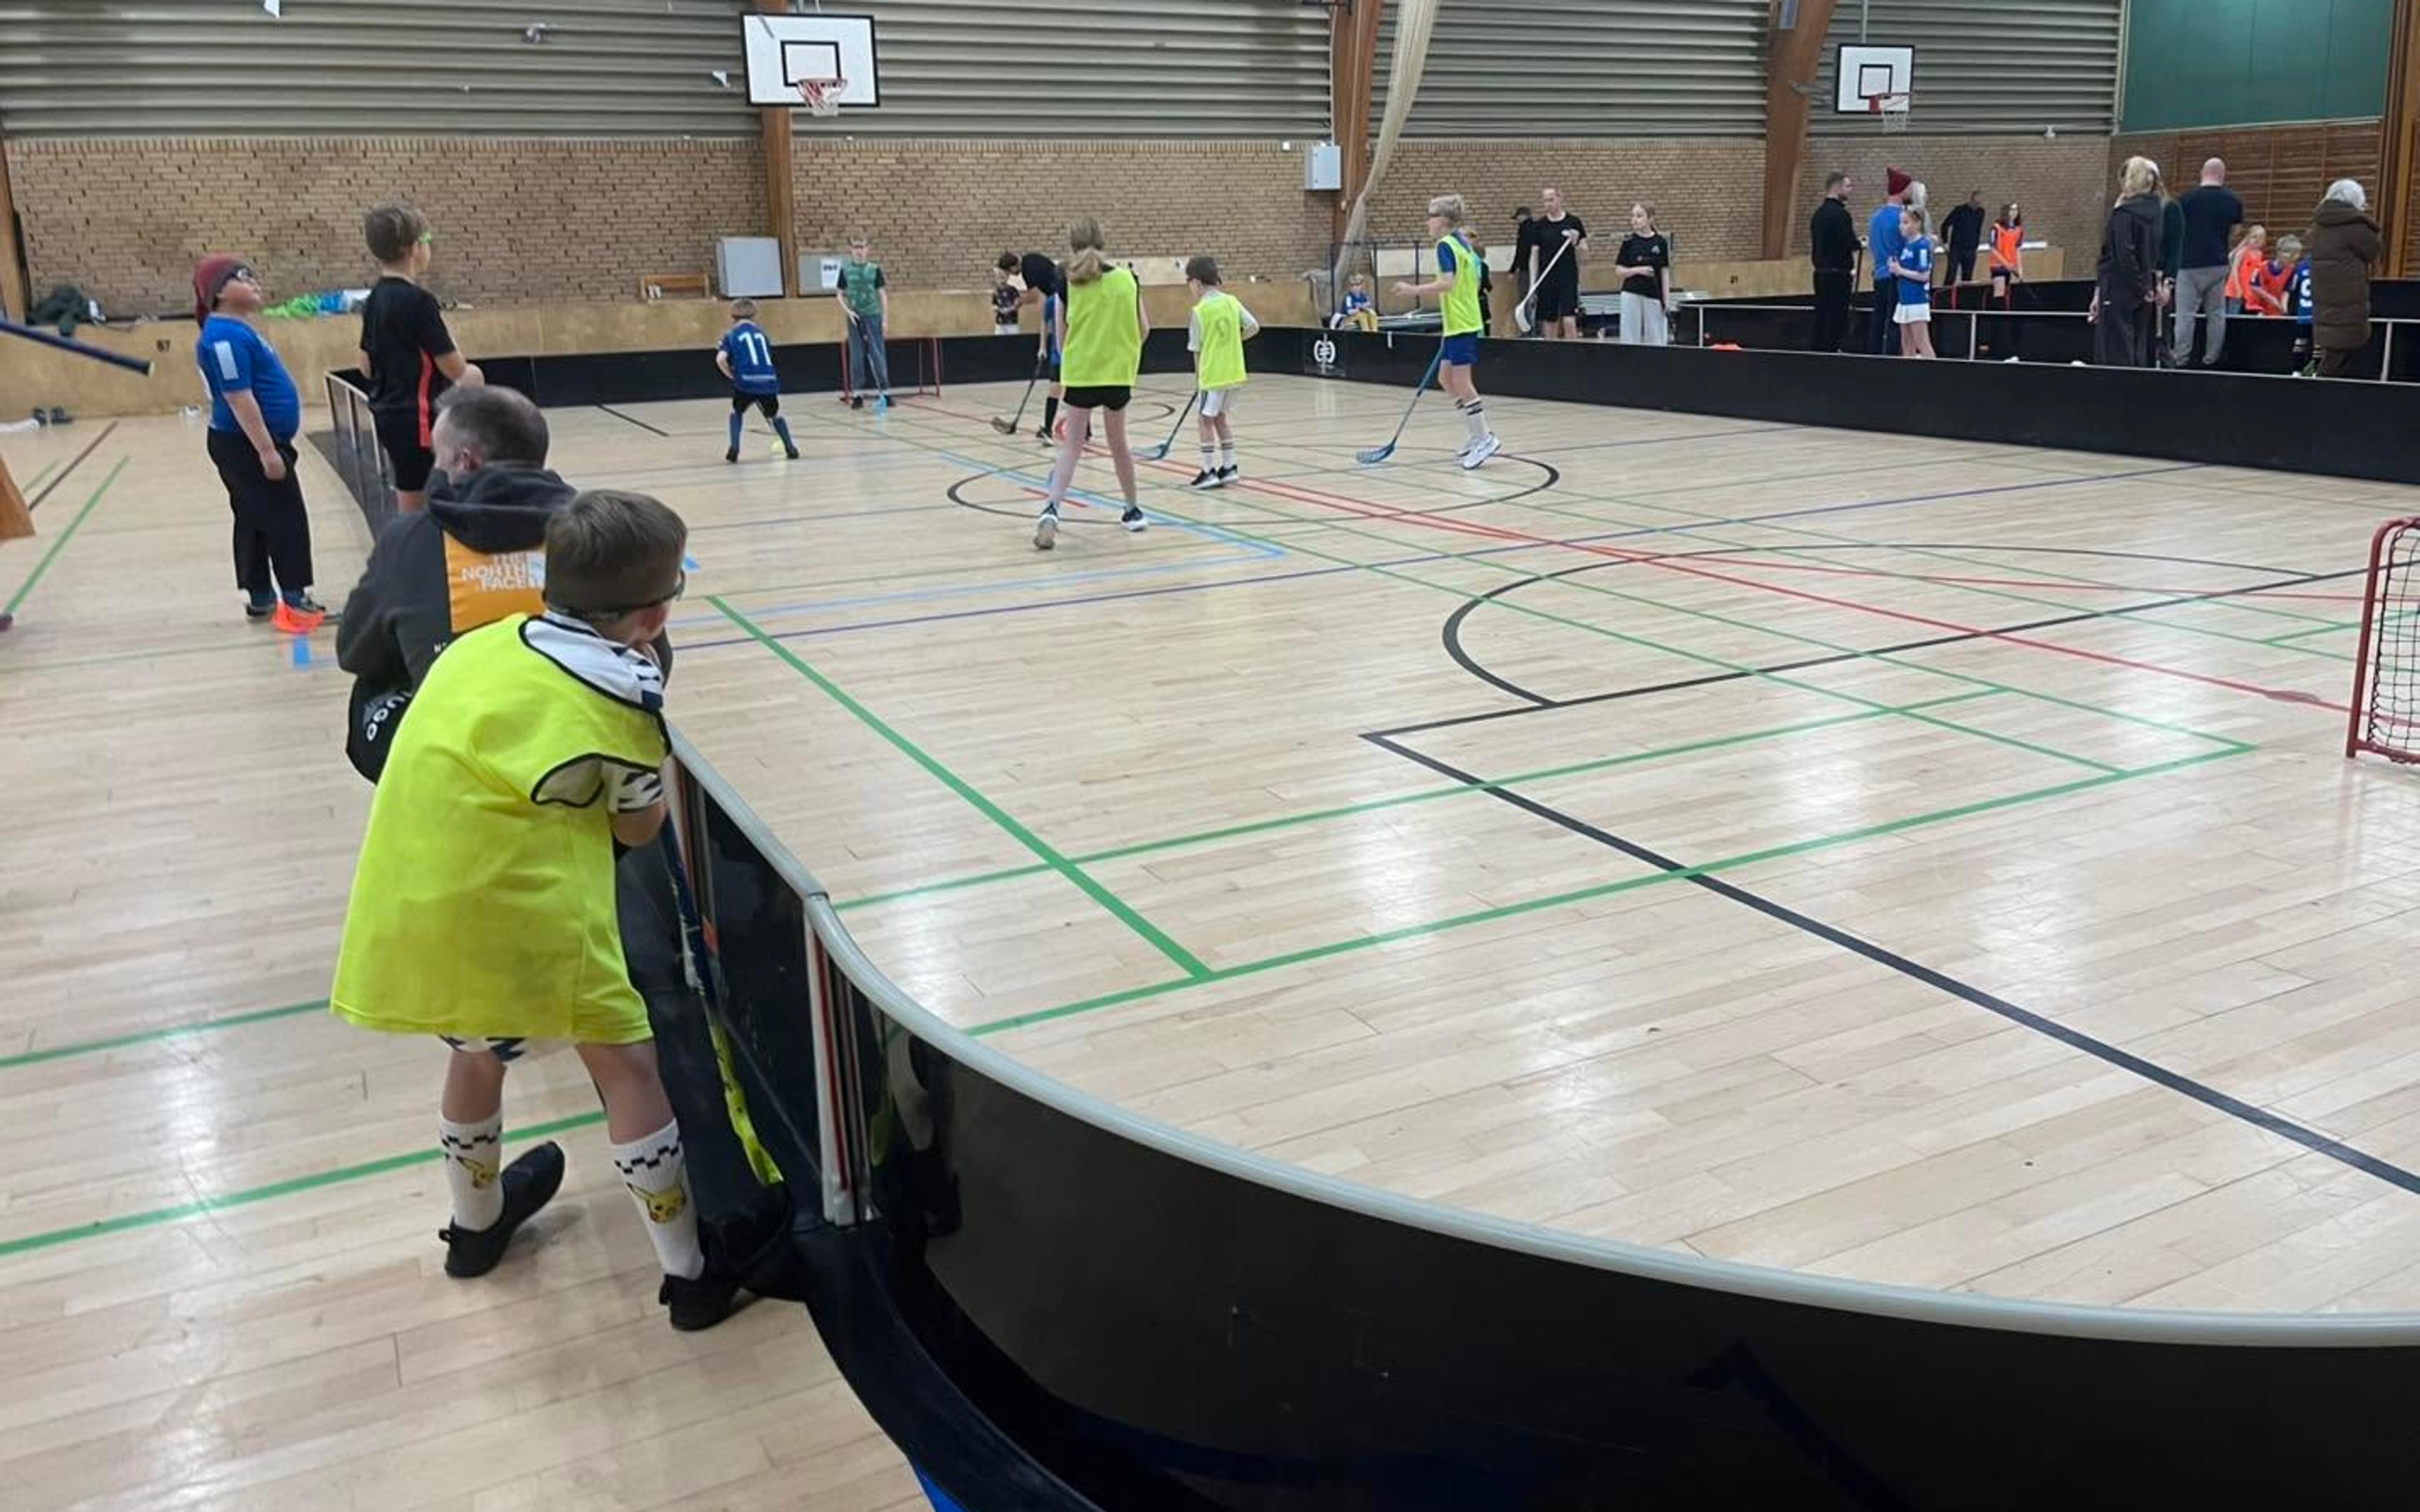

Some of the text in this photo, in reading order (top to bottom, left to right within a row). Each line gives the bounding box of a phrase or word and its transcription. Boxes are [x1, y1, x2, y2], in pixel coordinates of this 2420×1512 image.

[738, 332, 772, 366] 11
[461, 564, 527, 580] NORTH
[481, 576, 526, 590] FACE
